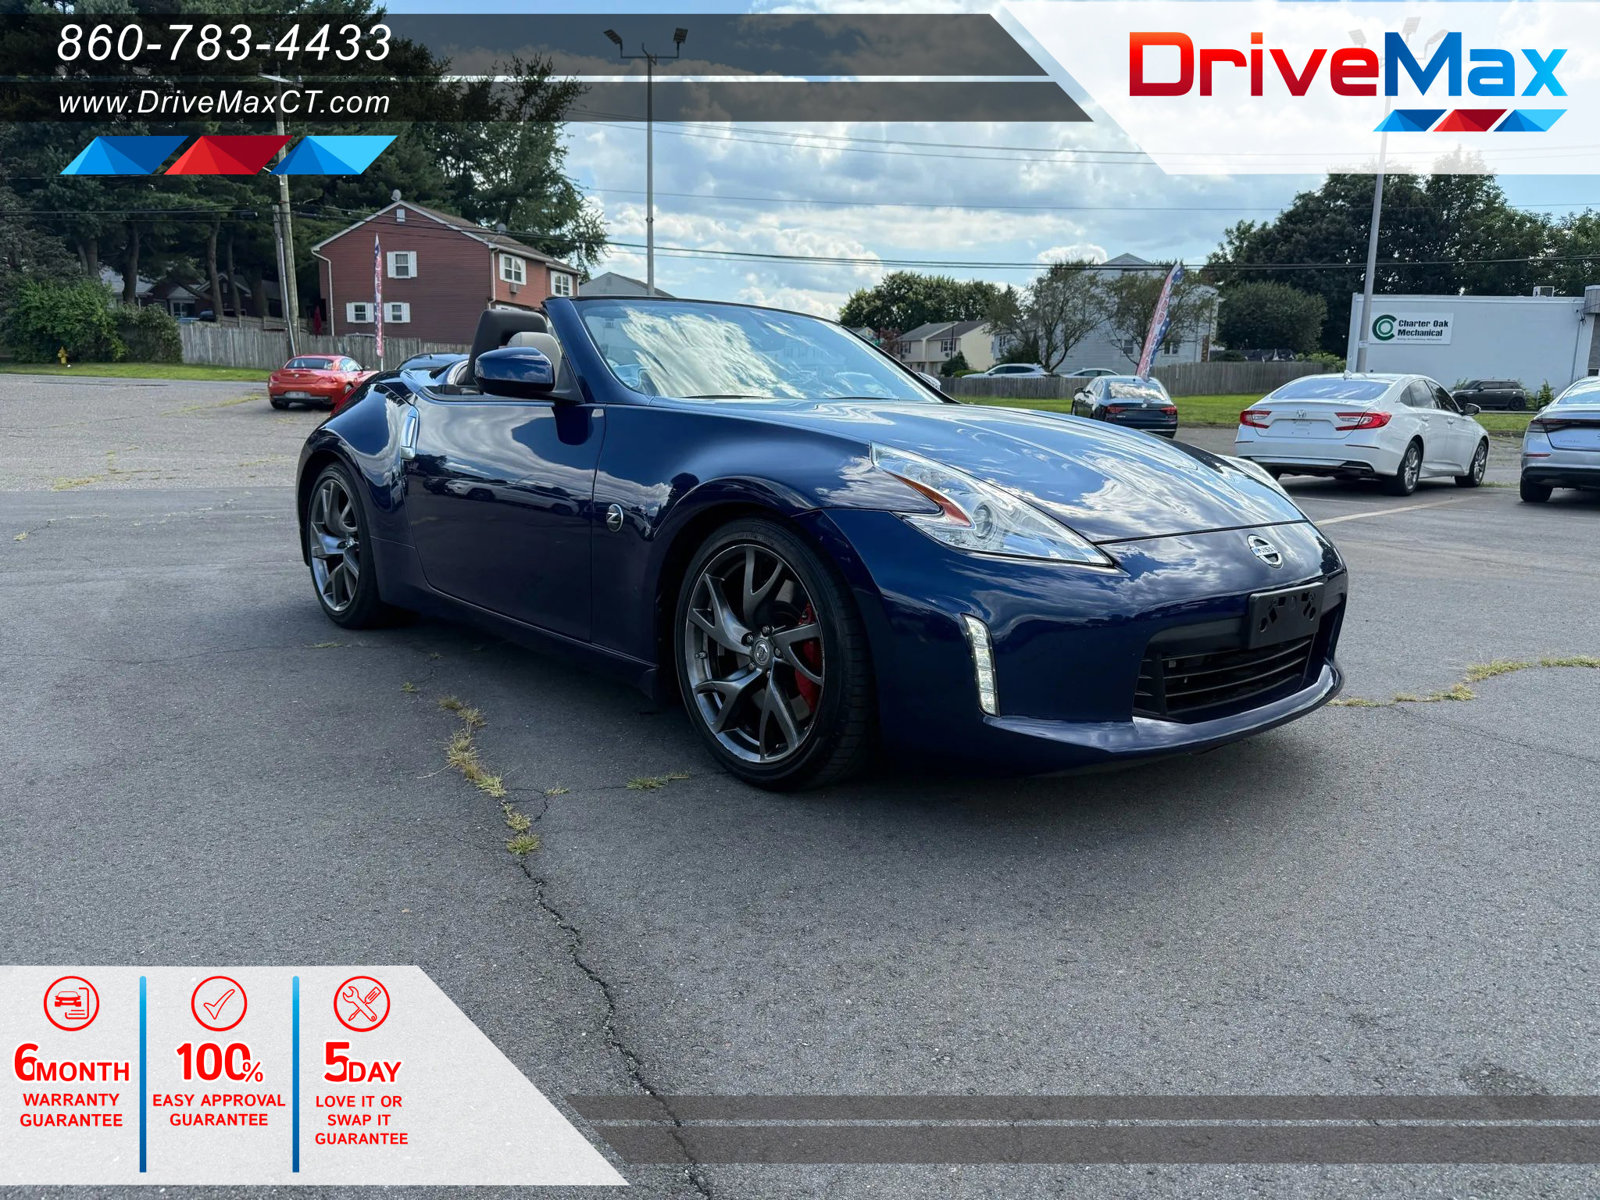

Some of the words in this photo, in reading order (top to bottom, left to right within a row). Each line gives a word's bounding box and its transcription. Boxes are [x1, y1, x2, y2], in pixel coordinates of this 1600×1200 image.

[1398, 319, 1431, 328] Charter
[1433, 319, 1449, 328] Oak
[1397, 329, 1443, 337] Mechanical
